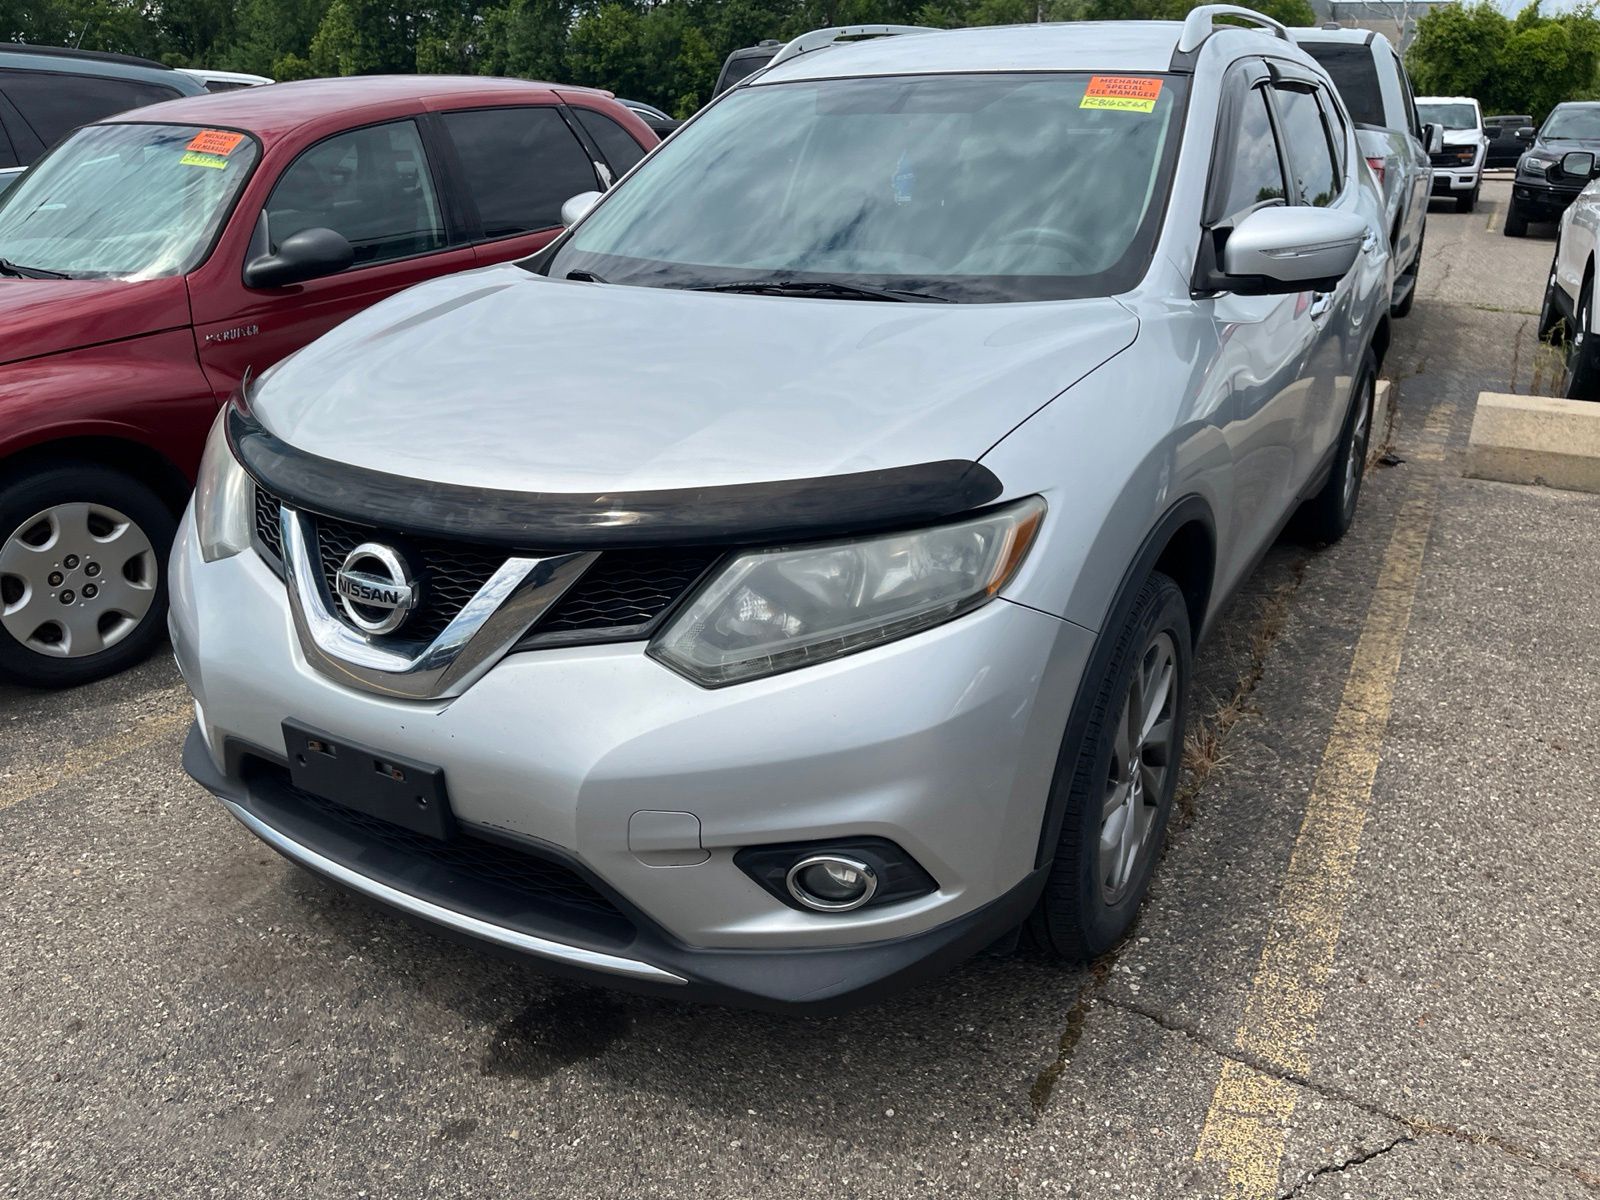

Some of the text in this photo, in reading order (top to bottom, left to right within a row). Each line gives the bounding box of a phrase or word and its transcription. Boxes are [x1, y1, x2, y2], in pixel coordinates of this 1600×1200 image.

[1100, 78, 1153, 86] MECHANICS
[1108, 89, 1157, 98] MANAGER
[339, 579, 398, 604] NISSAN
